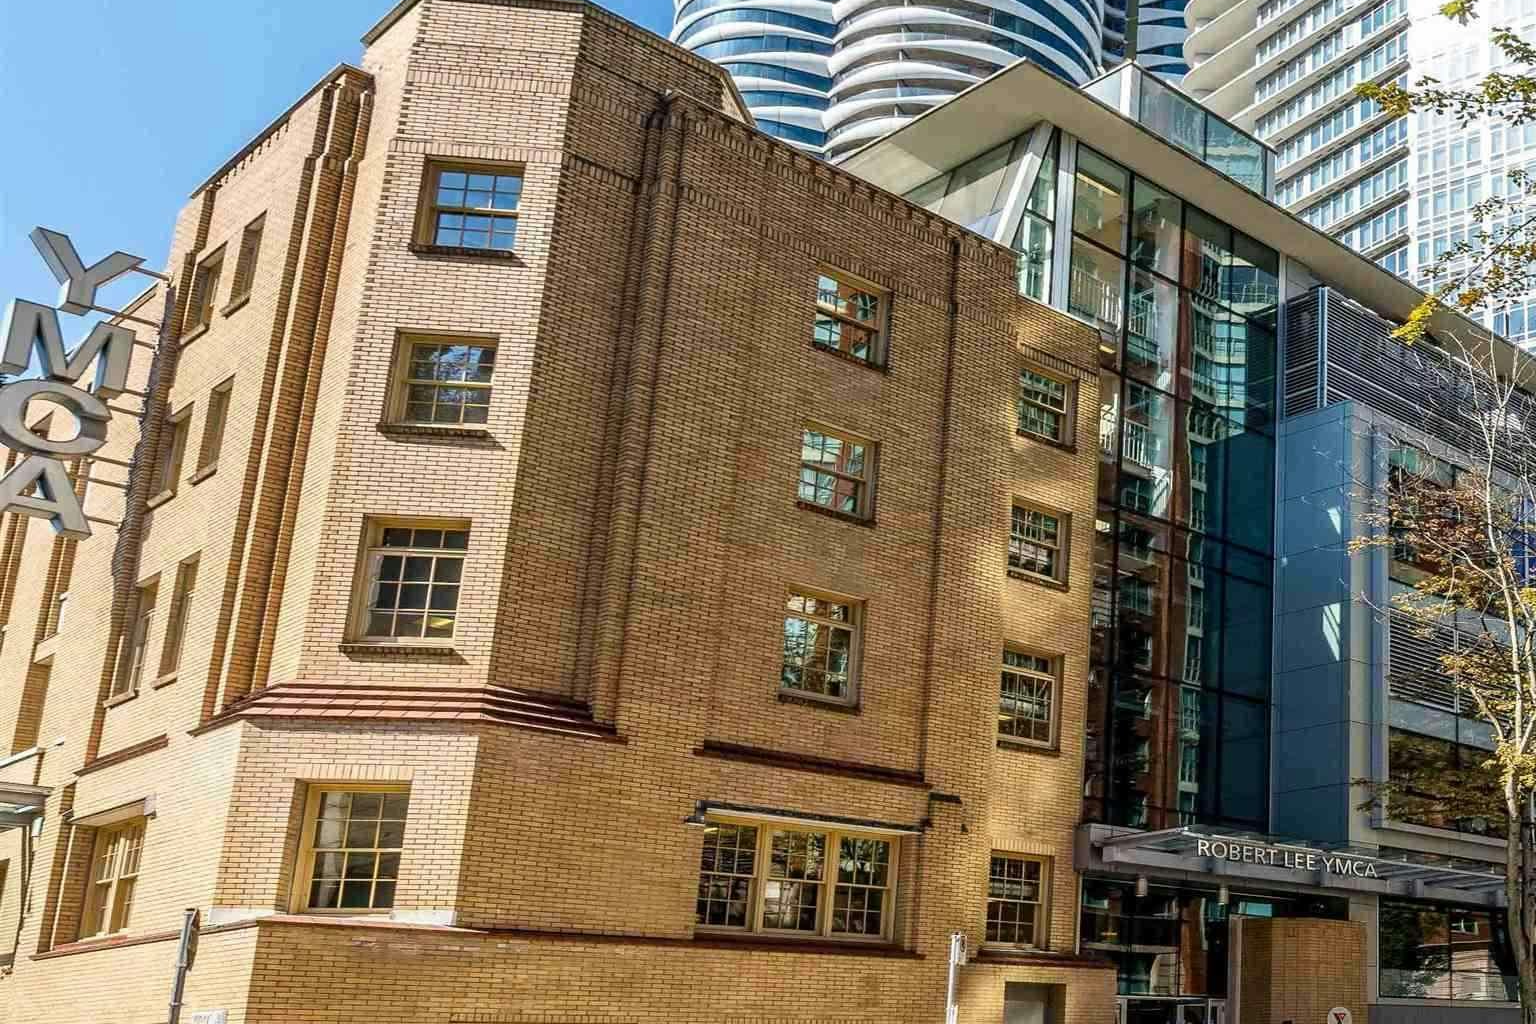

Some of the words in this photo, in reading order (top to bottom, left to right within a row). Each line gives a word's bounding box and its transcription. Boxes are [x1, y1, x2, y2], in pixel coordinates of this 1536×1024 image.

[0, 225, 147, 541] YMCA
[1197, 839, 1278, 865] ROBERT
[1284, 852, 1320, 871] LEE
[1322, 857, 1377, 878] YMCA
